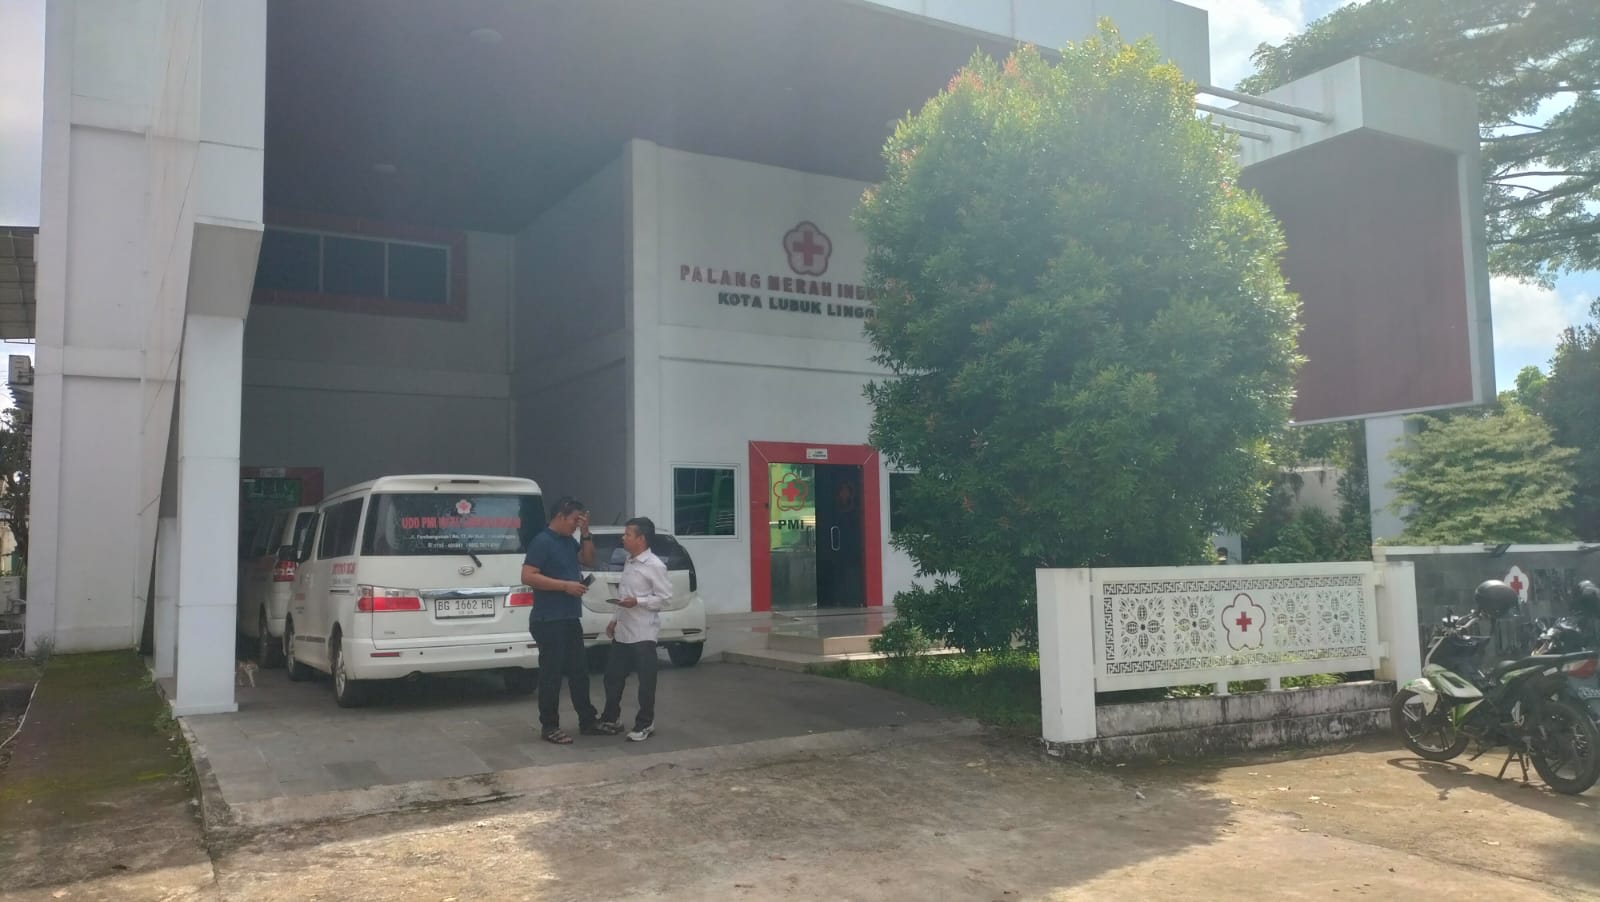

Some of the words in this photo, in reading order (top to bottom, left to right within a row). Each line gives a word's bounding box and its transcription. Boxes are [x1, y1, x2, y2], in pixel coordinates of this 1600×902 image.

[680, 264, 761, 288] PALANG
[767, 275, 832, 297] MERAH
[718, 292, 762, 308] KOTA
[769, 297, 822, 314] LUBUK
[778, 520, 804, 530] PMI
[438, 601, 450, 611] BG
[455, 600, 478, 610] 1662
[481, 599, 493, 609] HG
